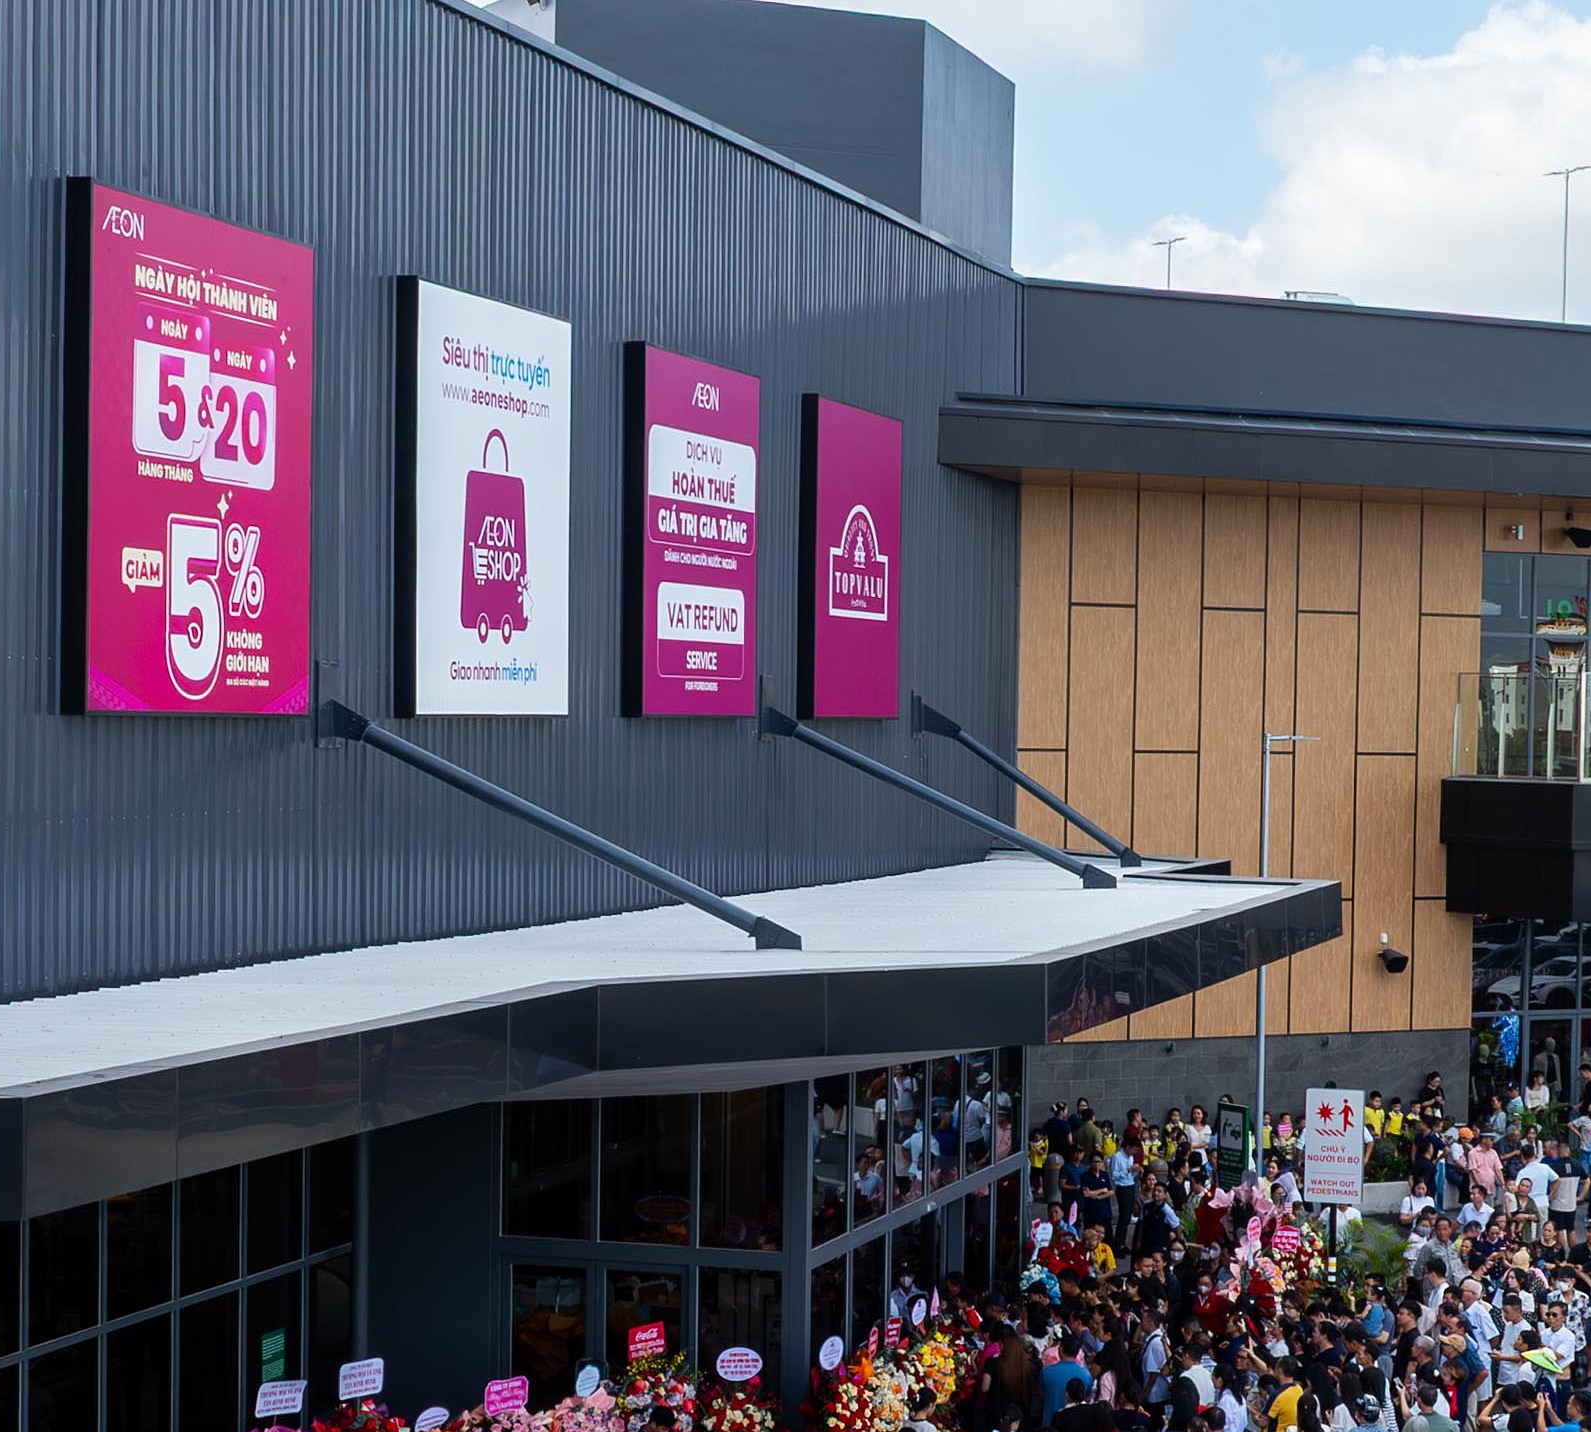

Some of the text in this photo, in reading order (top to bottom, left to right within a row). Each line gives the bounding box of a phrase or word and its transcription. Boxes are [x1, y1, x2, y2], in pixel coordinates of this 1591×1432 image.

[134, 262, 278, 322] NGÀY HỘI THÀNH VIÊN
[160, 317, 189, 341] NGÀY
[226, 348, 252, 372] NGÀY
[443, 336, 551, 391] Siêu thị trực tuyến
[159, 355, 186, 442] 5
[214, 386, 267, 466] 20
[442, 382, 550, 420] www.aeoneshop.com
[686, 440, 722, 468] DỊCH VỤ
[138, 460, 194, 484] HÀNG THÁNG
[672, 467, 737, 505] HOÀN THUẾ
[658, 503, 747, 545] GIÁ TRỊ GIA TĂNG
[125, 552, 161, 585] GIẢM
[835, 571, 883, 599] TOPVALU
[668, 602, 738, 633] VAT REFUND
[227, 628, 263, 650] KHÔNG
[226, 651, 270, 677] GIỚI HẠN
[450, 656, 538, 684] Giao nhanh miễn phí
[686, 650, 718, 671] SERVICE
[1307, 1188, 1359, 1197] PEDESTRIANS
[1311, 1178, 1355, 1188] WATCH OUT
